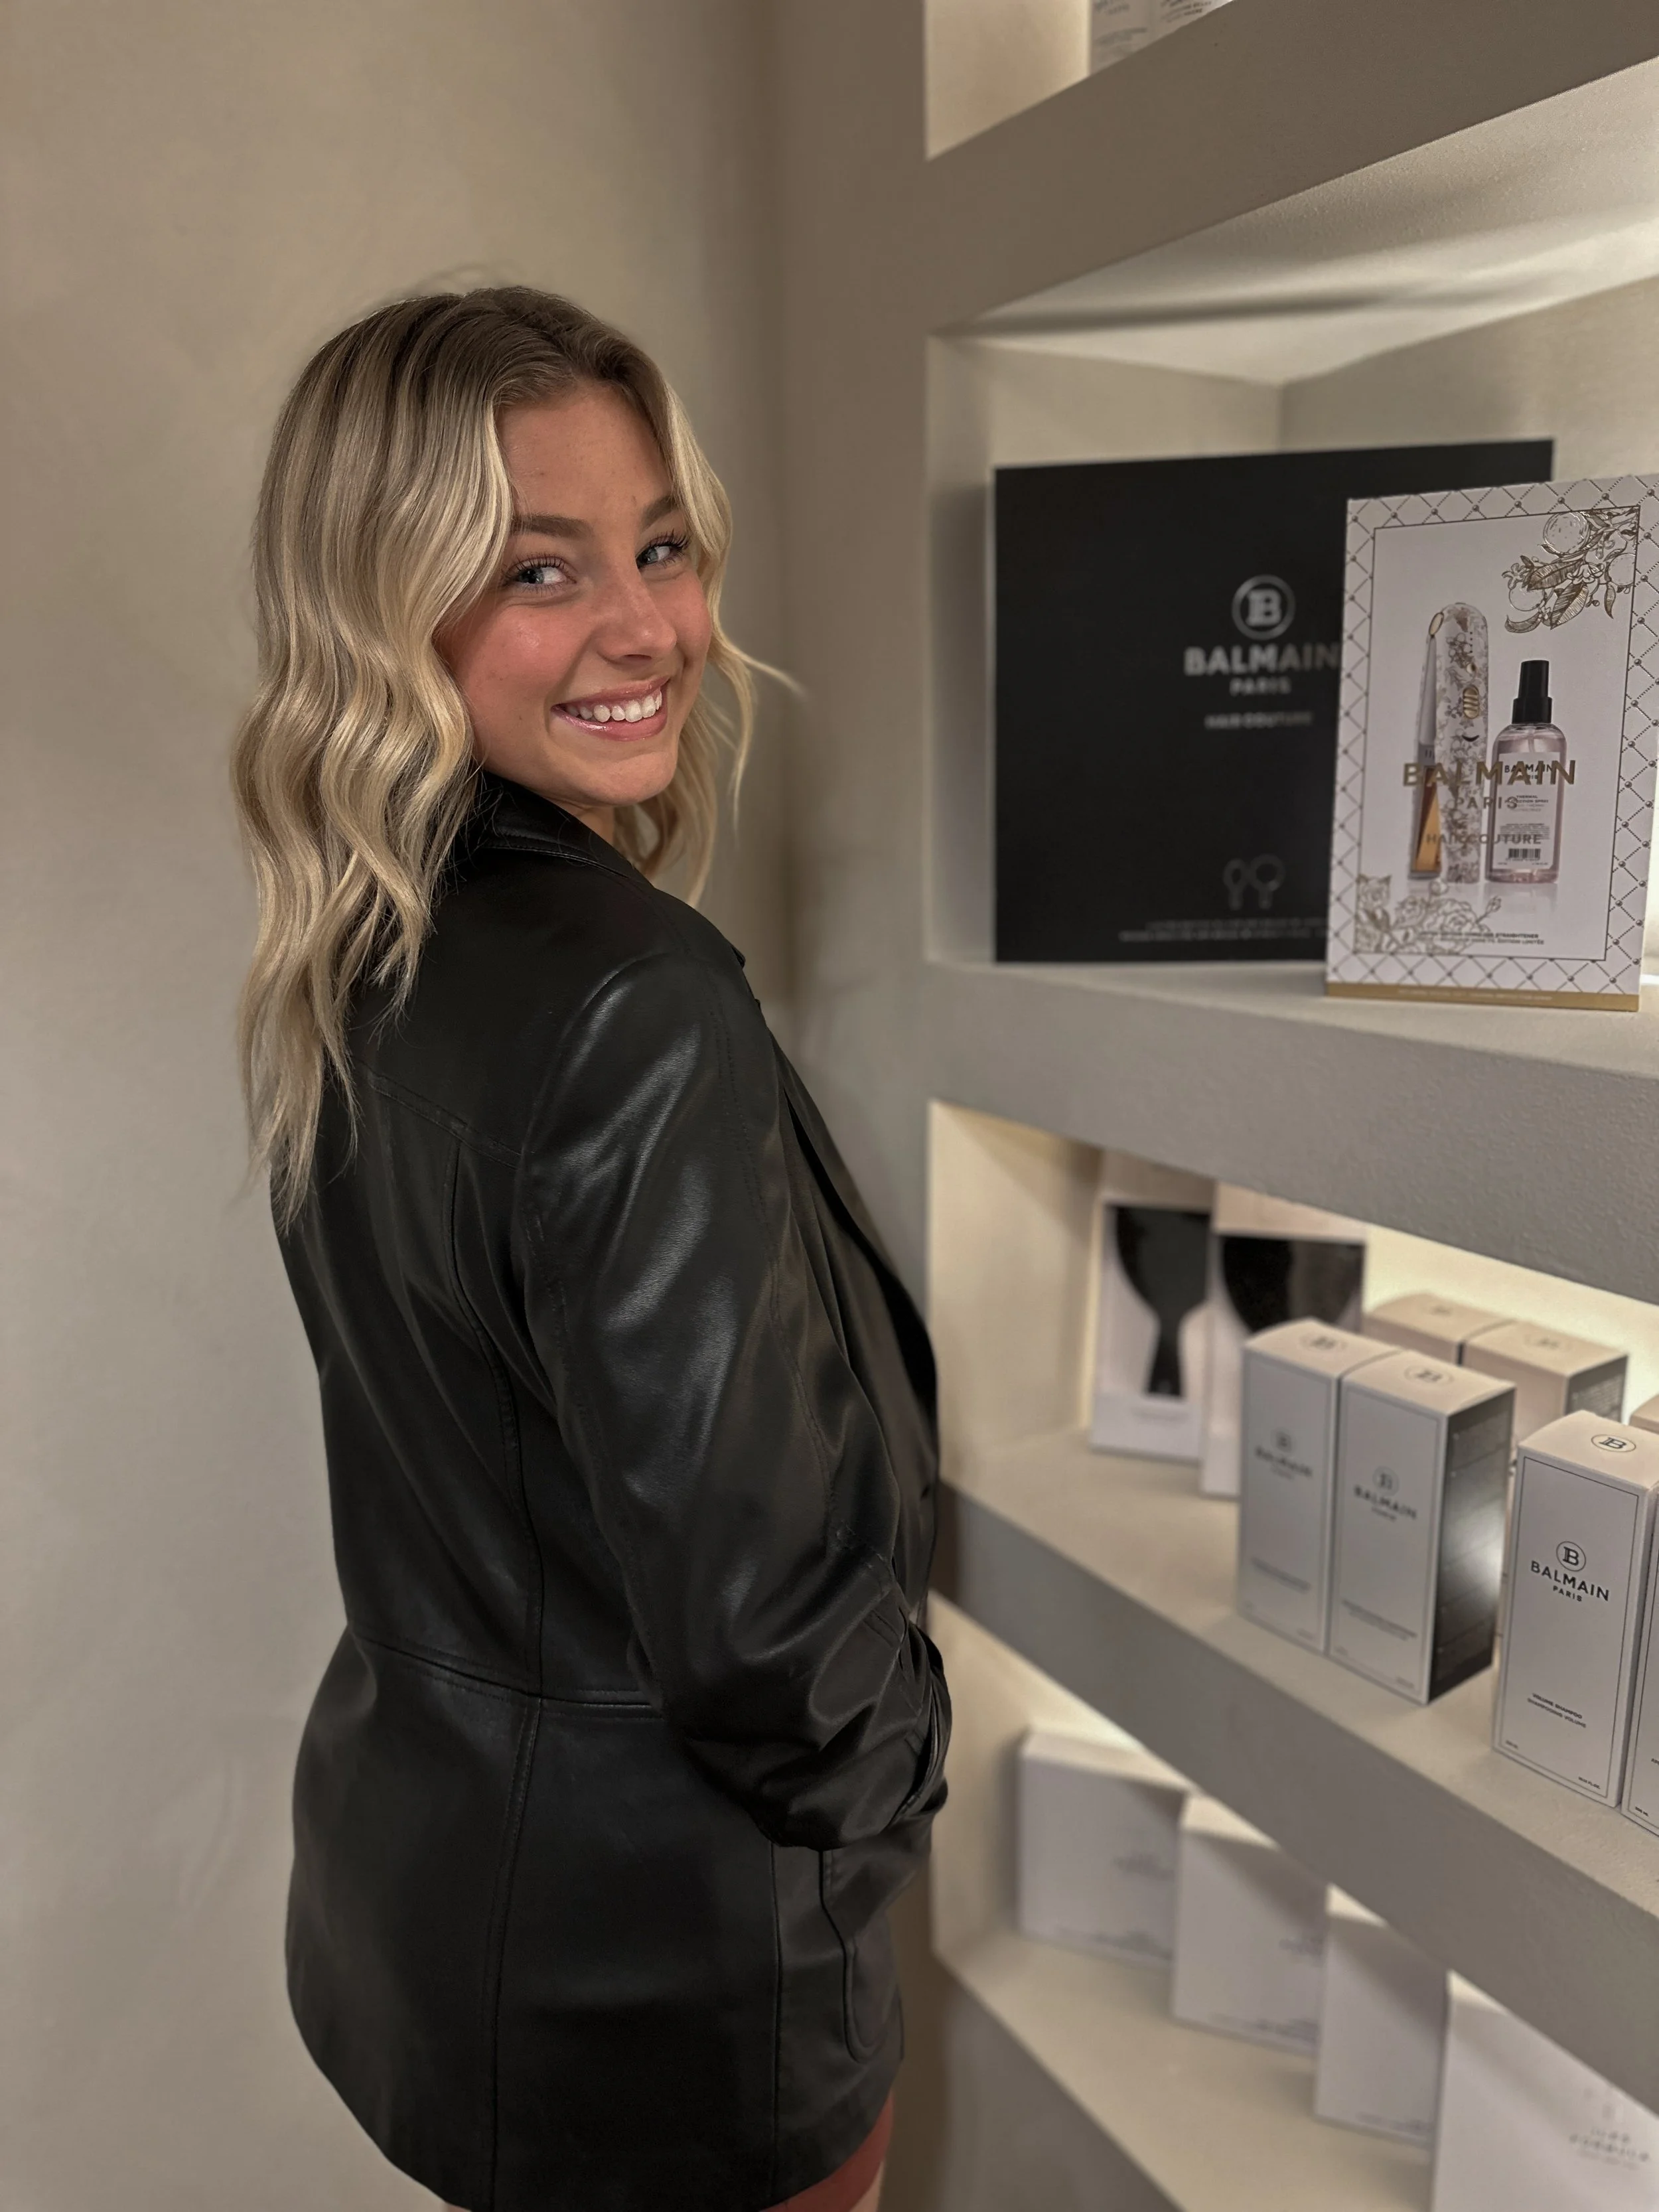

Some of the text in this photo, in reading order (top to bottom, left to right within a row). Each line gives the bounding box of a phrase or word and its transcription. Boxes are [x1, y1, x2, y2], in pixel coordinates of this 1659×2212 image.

[1246, 589, 1282, 627] B
[1183, 643, 1341, 676] BALMAIN
[1403, 761, 1576, 786] BALMAIN
[1504, 764, 1553, 773] BAMAIN
[1455, 796, 1518, 810] PARIS
[1467, 833, 1542, 845] COUTURE
[1599, 1437, 1626, 1449] B
[1562, 1546, 1579, 1567] B
[1530, 1560, 1610, 1602] BALMAIN
[1553, 1585, 1583, 1603] PARIS
[1532, 1692, 1583, 1719] VOLUME SHAMPOO
